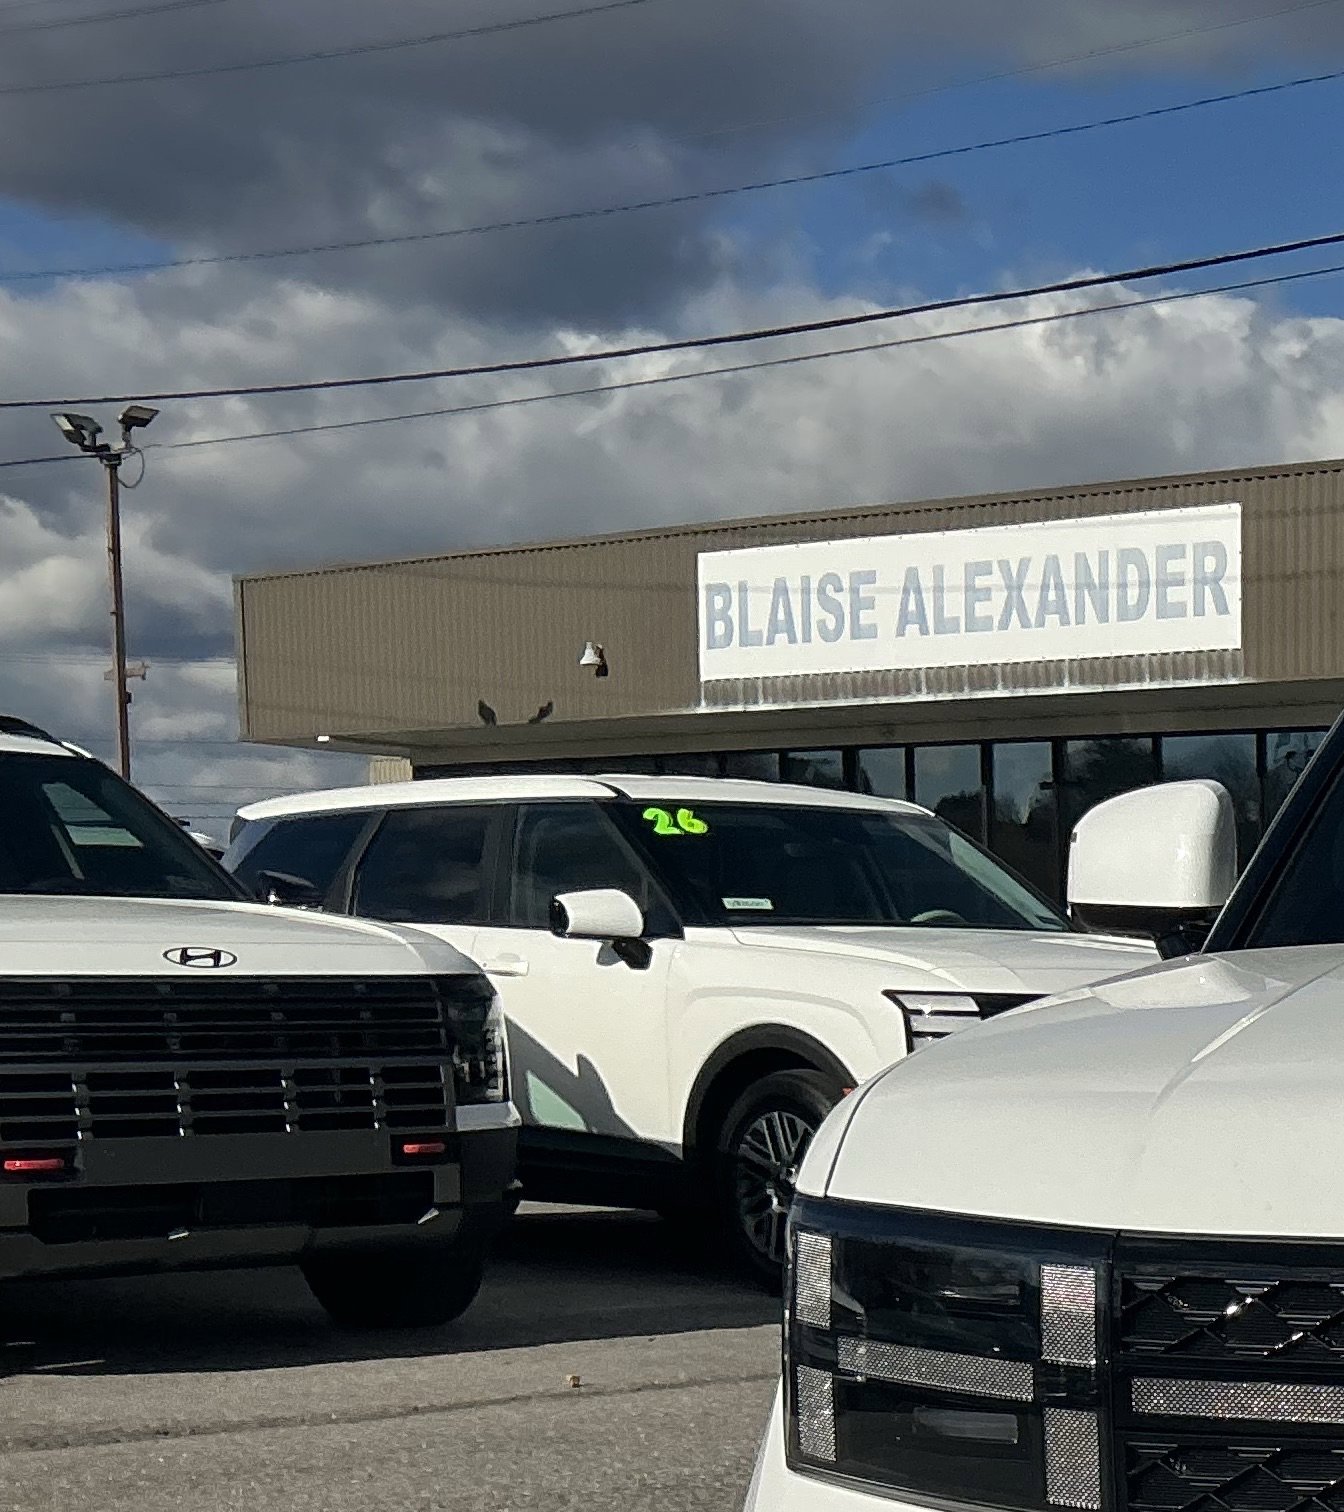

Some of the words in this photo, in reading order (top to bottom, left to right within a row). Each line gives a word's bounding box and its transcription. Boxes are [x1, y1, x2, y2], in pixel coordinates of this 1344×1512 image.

[705, 569, 879, 650] BLAISE
[895, 540, 1231, 639] ALEXANDER
[643, 807, 708, 835] 26
